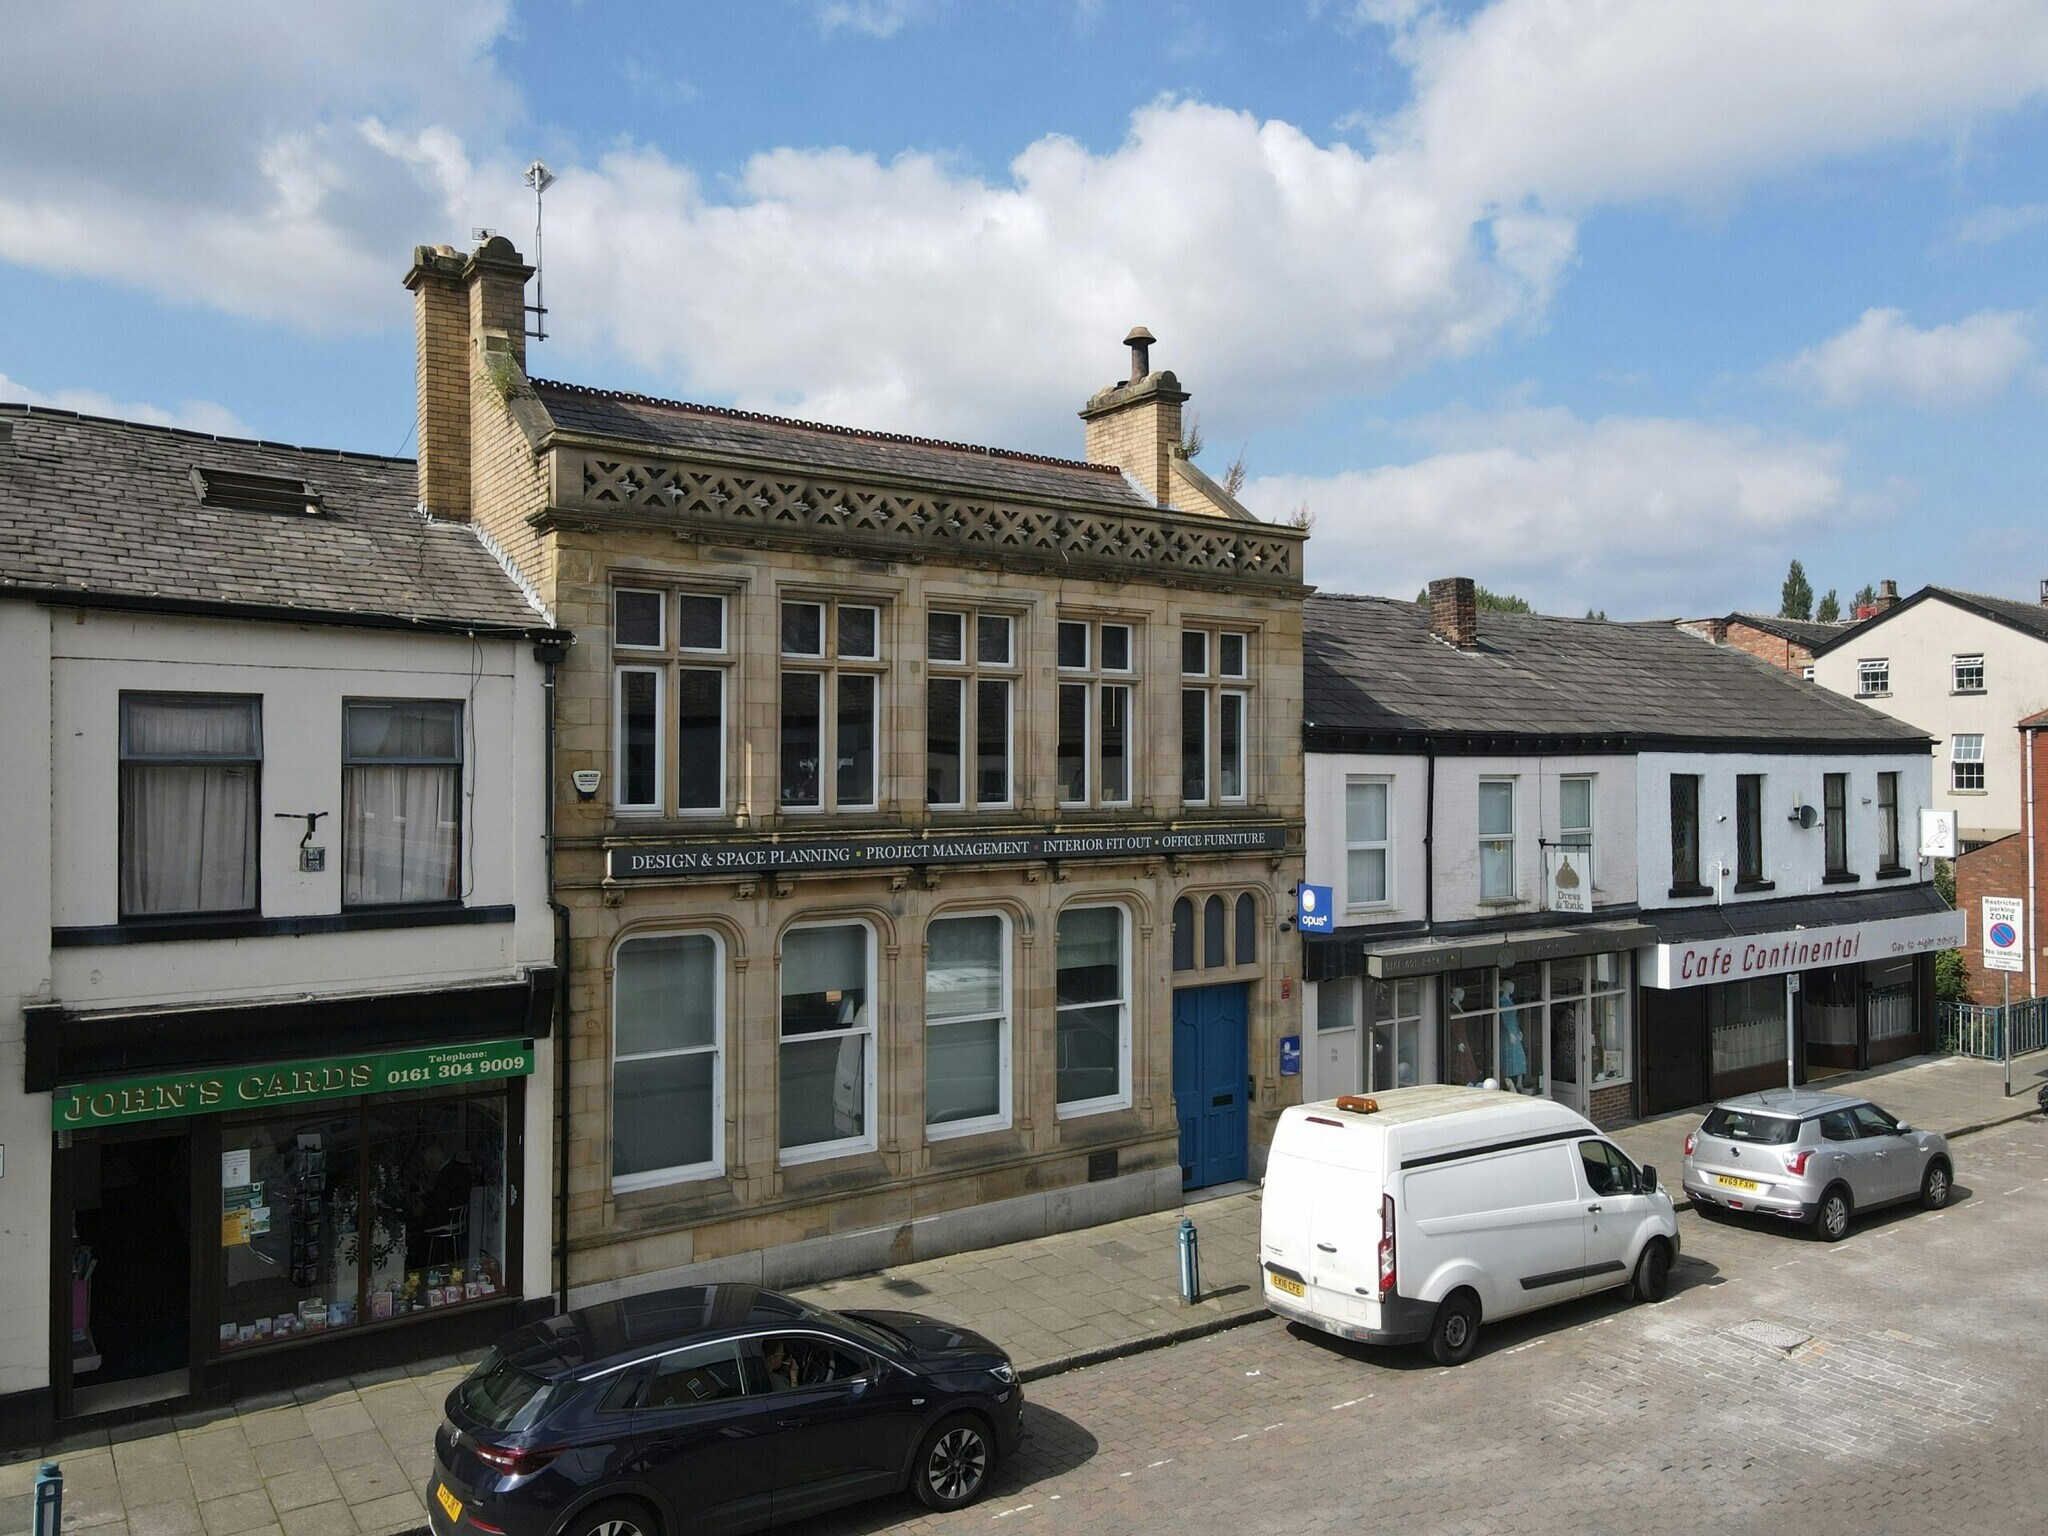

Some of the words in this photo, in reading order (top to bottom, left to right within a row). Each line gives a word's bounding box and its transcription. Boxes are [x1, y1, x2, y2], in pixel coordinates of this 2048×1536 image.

[631, 853, 697, 870] DESIGN
[700, 853, 713, 868] &
[716, 851, 767, 867] SPACE
[770, 847, 850, 864] PLANNING
[866, 844, 929, 860] PROJECT
[932, 841, 1030, 857] MANAGEMENT
[1043, 838, 1106, 853] INTERIOR
[1106, 837, 1126, 851] FIT
[1126, 836, 1152, 849] OUT
[1162, 834, 1202, 848] OFFICE
[1204, 832, 1266, 846] FURNITURE
[1557, 891, 1581, 901] Dress
[1555, 900, 1563, 909] &
[1563, 901, 1585, 910] Tonic
[1984, 898, 2020, 907] Restricted
[1989, 906, 2016, 914] parking
[1990, 913, 2016, 921] ZONE
[1682, 947, 1732, 980] Café
[1743, 931, 1861, 972] Continental
[1996, 949, 2021, 957] loading
[428, 1050, 488, 1063] Telephone:
[387, 1068, 431, 1084] 0161
[438, 1064, 474, 1078] 304
[480, 1056, 525, 1073] 9009
[64, 1079, 223, 1121] JOHN'S
[238, 1064, 373, 1100] CARDS
[1739, 1179, 1755, 1189] FXH
[1288, 1281, 1300, 1294] CFE
